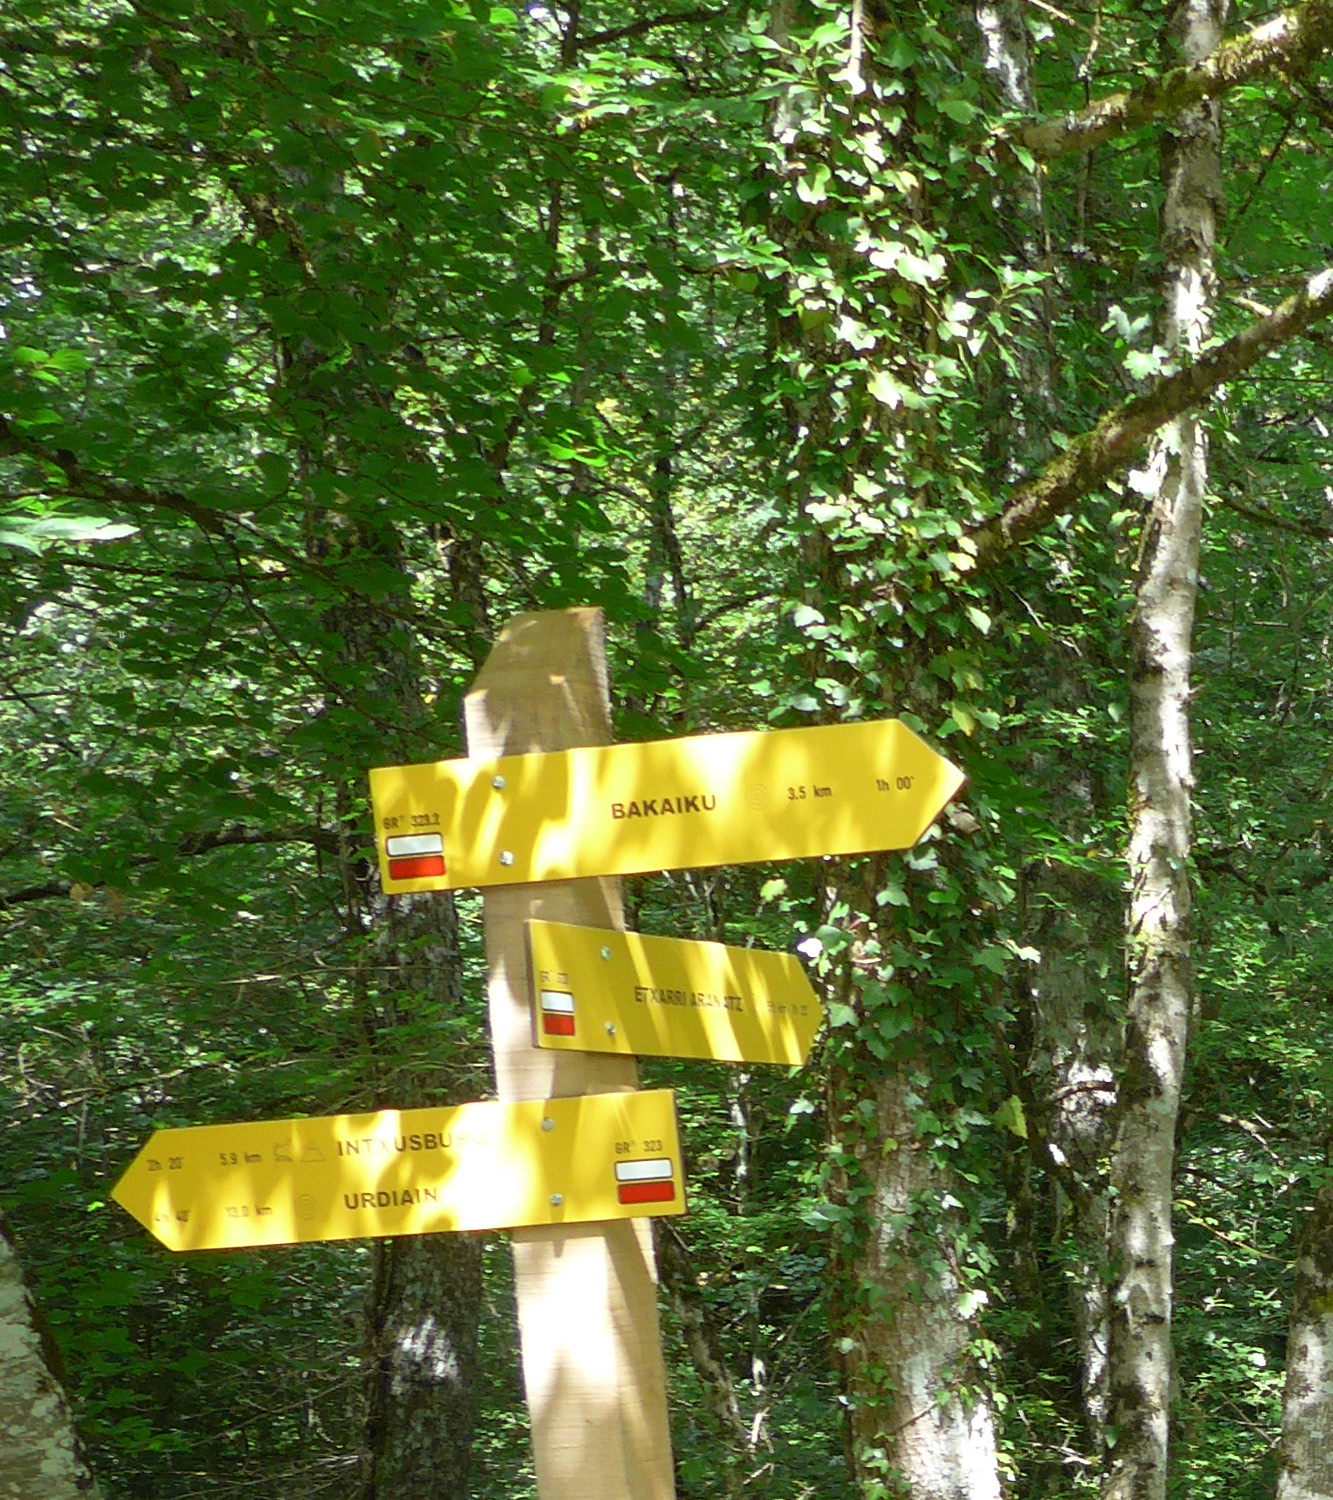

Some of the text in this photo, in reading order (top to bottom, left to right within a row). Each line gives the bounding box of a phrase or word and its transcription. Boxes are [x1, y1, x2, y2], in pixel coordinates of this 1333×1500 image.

[611, 794, 716, 819] BAKAIKU
[787, 786, 806, 800] 3.5
[813, 785, 832, 798] km
[876, 779, 891, 791] 1h
[244, 1150, 263, 1164] km
[336, 1131, 489, 1157] INTXUSBUU
[254, 1203, 273, 1217] km
[344, 1187, 438, 1210] URDIAIN
